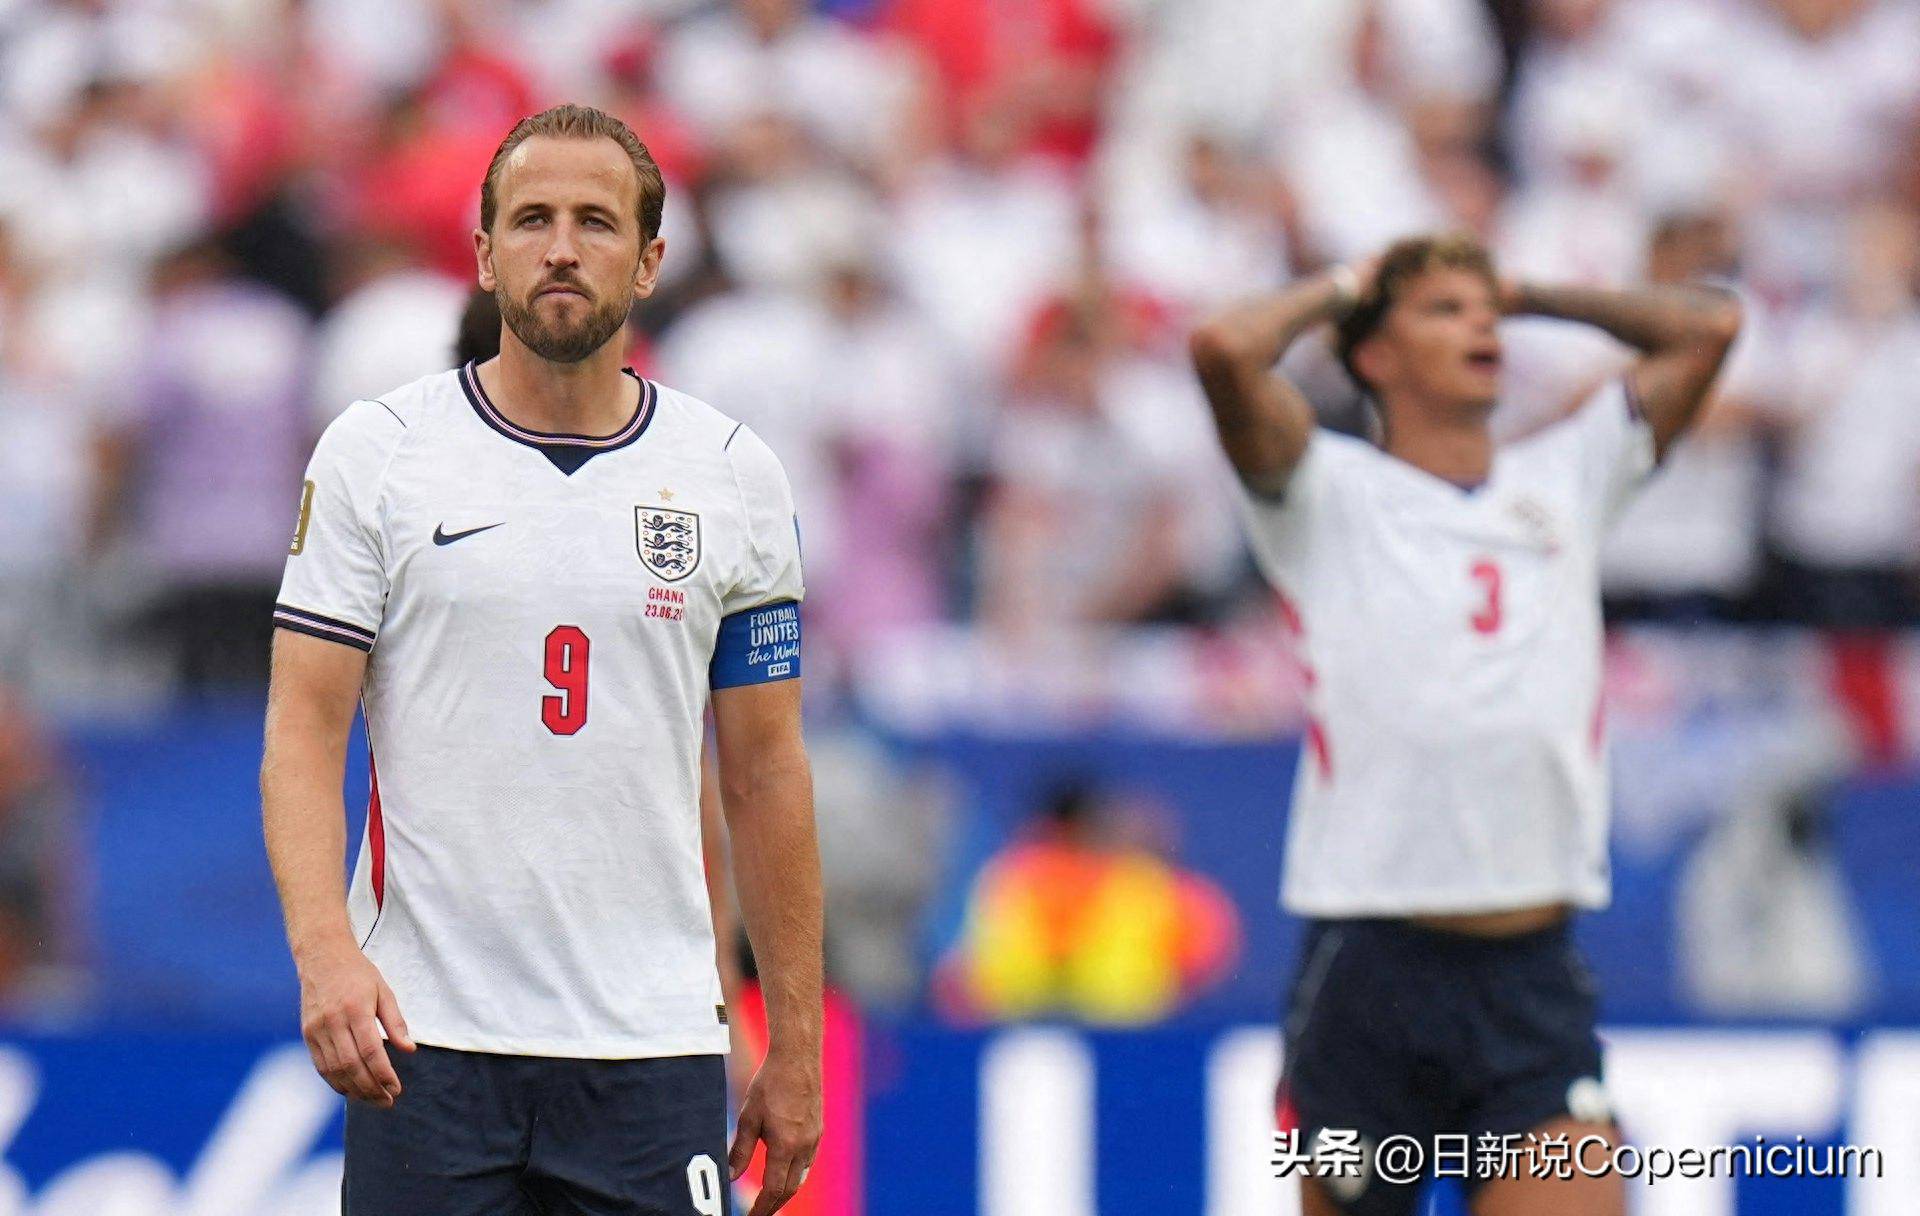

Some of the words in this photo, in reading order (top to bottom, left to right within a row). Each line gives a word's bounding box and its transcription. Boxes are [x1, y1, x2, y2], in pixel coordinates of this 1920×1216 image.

[648, 587, 684, 605] GHANA
[1471, 563, 1502, 635] 3
[750, 606, 797, 628] FOOTBALL
[751, 620, 799, 647] UNITES
[746, 648, 771, 665] the
[769, 663, 789, 675] FIFA
[541, 625, 590, 736] 9
